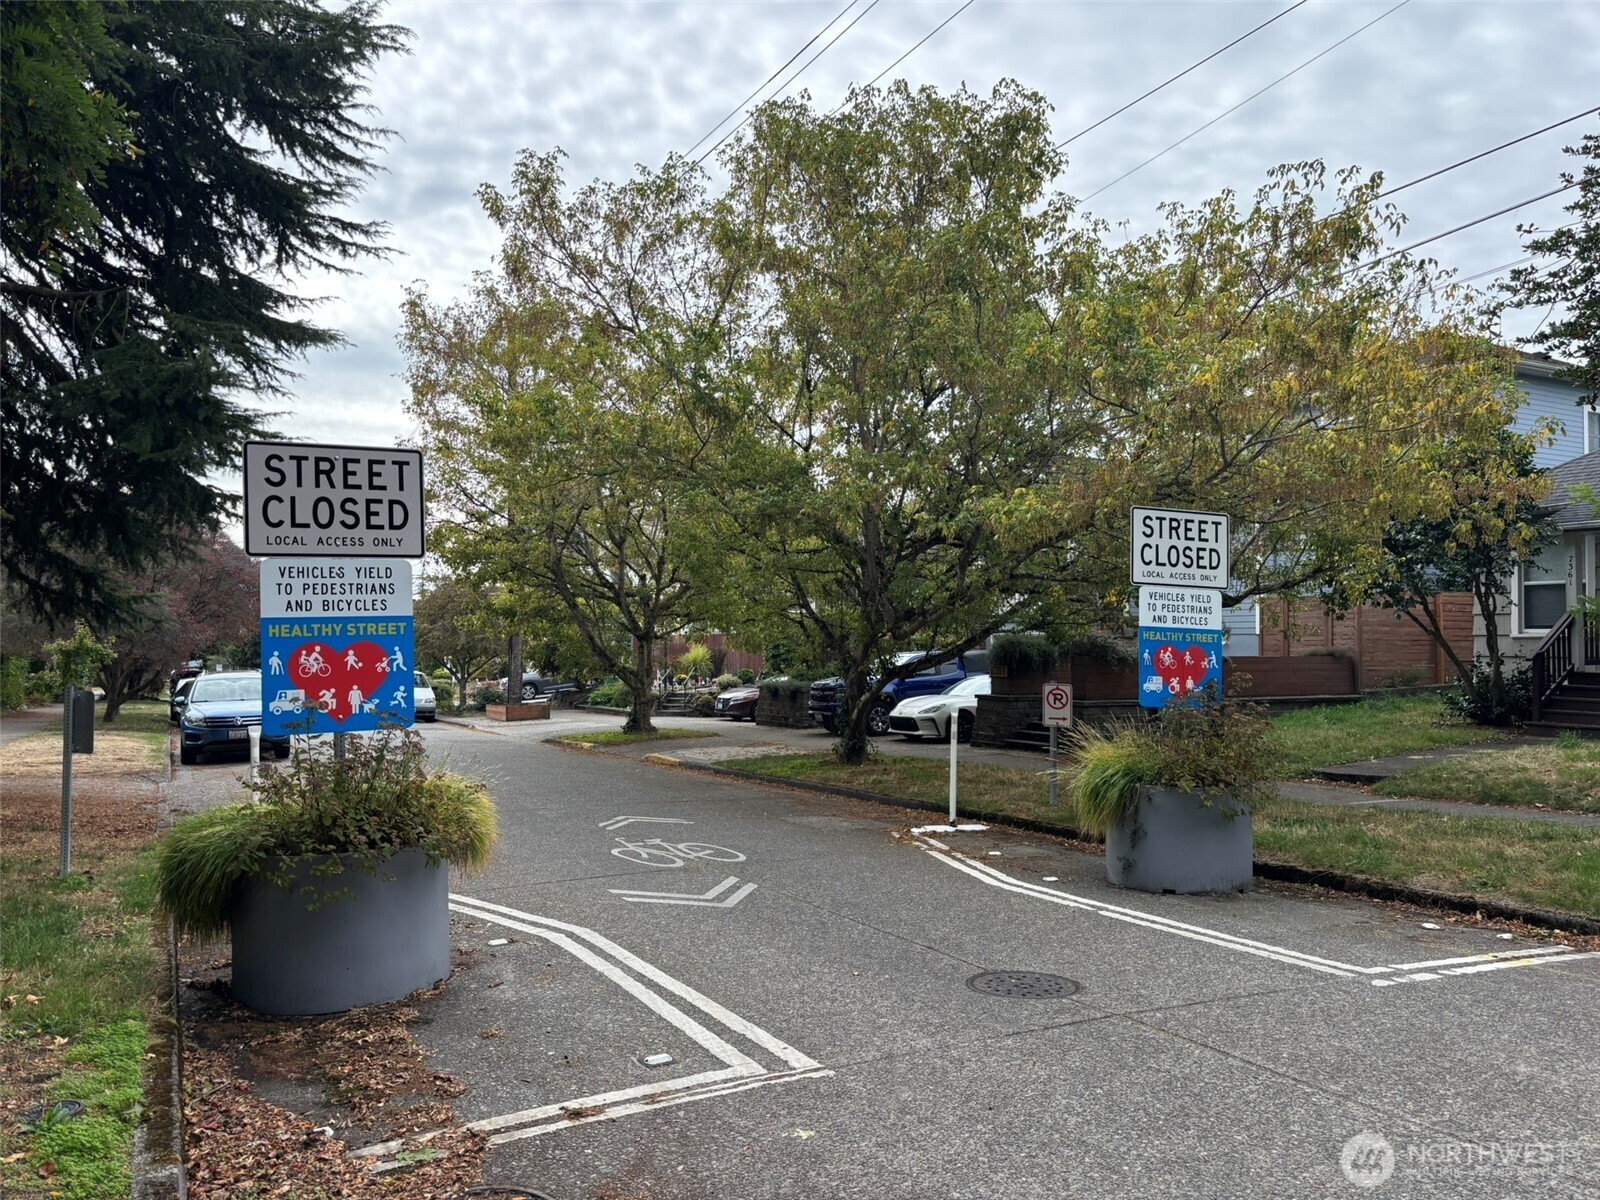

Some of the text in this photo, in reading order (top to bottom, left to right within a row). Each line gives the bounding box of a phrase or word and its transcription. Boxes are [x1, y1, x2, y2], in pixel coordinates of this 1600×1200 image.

[264, 453, 410, 492] STREET
[262, 494, 409, 531] CLOSED
[1142, 515, 1222, 543] STREET
[266, 535, 403, 547] LOCAL ACCESS ONLY
[1140, 542, 1221, 570] CLOSED
[278, 566, 393, 579] VEHICLES YIELD
[1142, 570, 1217, 582] LOCAL ACCESS ONLY
[276, 582, 395, 596] TO PEDESTRIANS
[1148, 591, 1212, 604] VEHICLES YIELD
[285, 598, 388, 612] AND BICYCLES
[1147, 602, 1213, 615] TO PEDESTRIANS
[1152, 614, 1209, 626] AND BICYCLES
[268, 622, 407, 638] HEALTHY STREET
[1143, 630, 1219, 643] HEALTHY STREET
